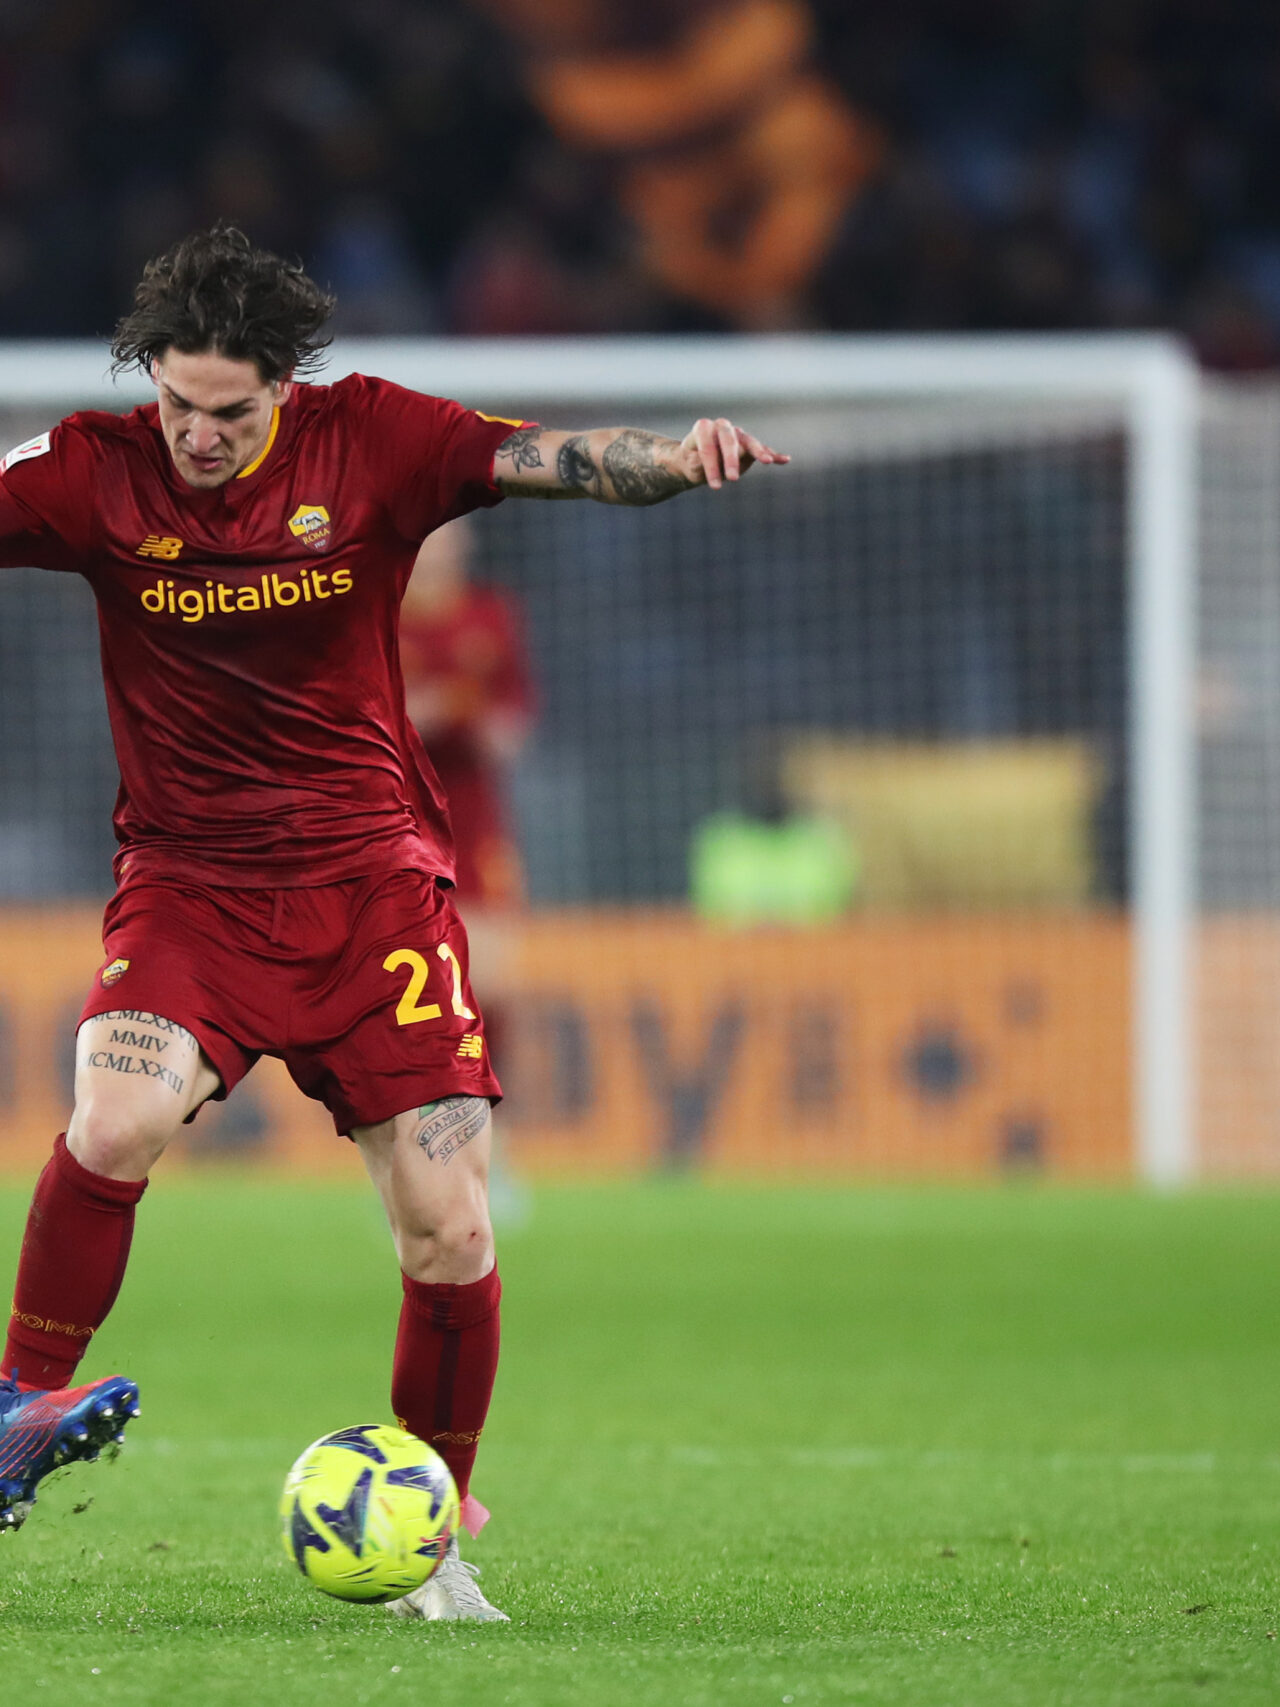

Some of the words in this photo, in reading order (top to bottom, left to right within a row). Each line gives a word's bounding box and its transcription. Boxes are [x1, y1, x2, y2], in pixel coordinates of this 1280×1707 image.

[302, 527, 330, 545] ROMA
[140, 568, 353, 623] digitalbits
[109, 1029, 169, 1053] MMIV
[88, 1052, 184, 1095] CMLXXIII
